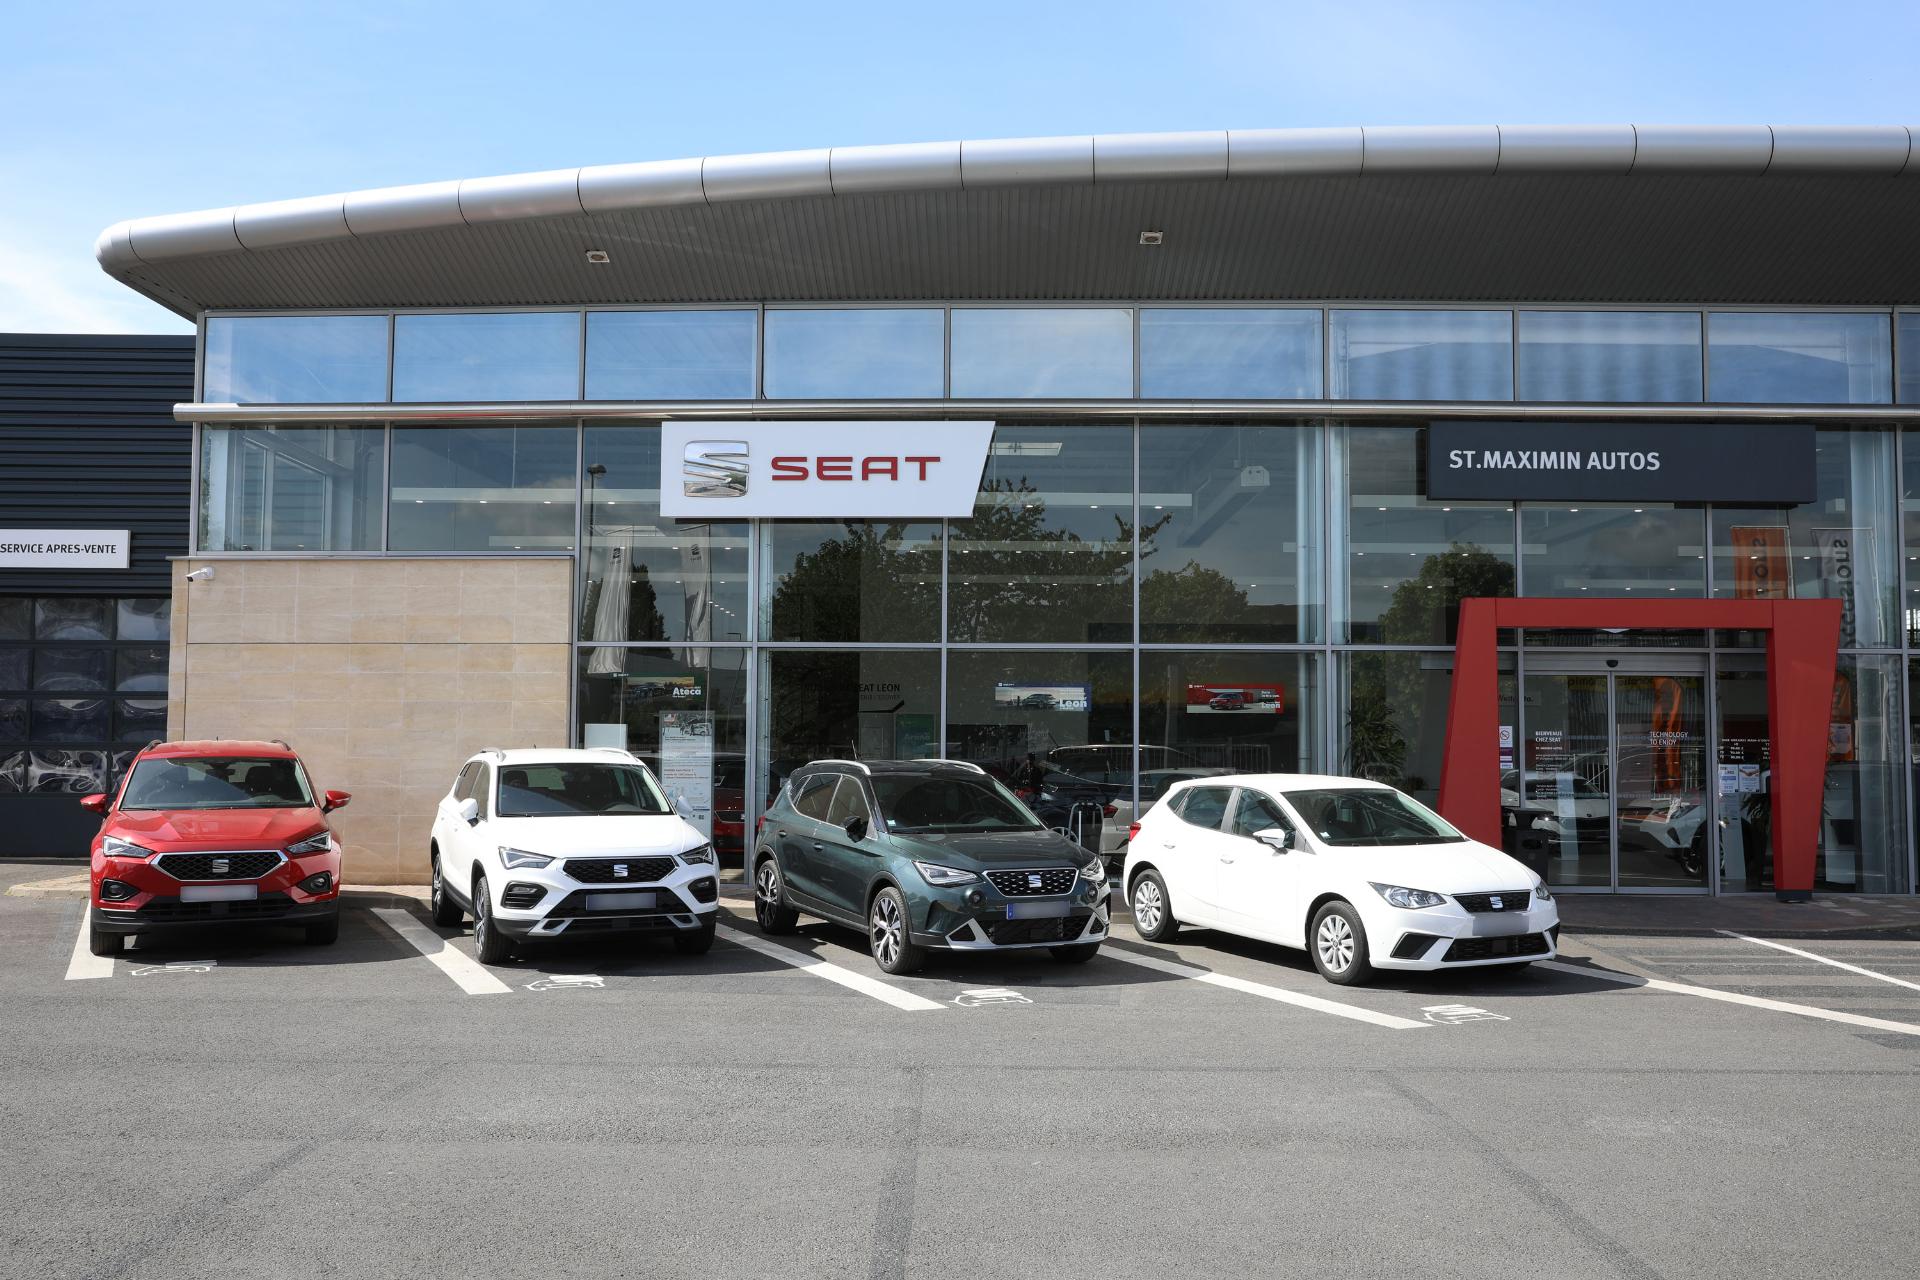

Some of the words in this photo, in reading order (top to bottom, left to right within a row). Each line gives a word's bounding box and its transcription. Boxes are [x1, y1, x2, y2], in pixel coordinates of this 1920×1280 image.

[1449, 449, 1581, 469] ST.MAXIMIN
[1586, 452, 1661, 470] AUTOS
[771, 457, 940, 481] SEAT
[0, 544, 43, 553] SERVICE
[46, 544, 117, 554] APRES-VENTE
[672, 687, 702, 696] Ateca
[877, 683, 900, 692] LEON
[1059, 699, 1088, 708] Leon
